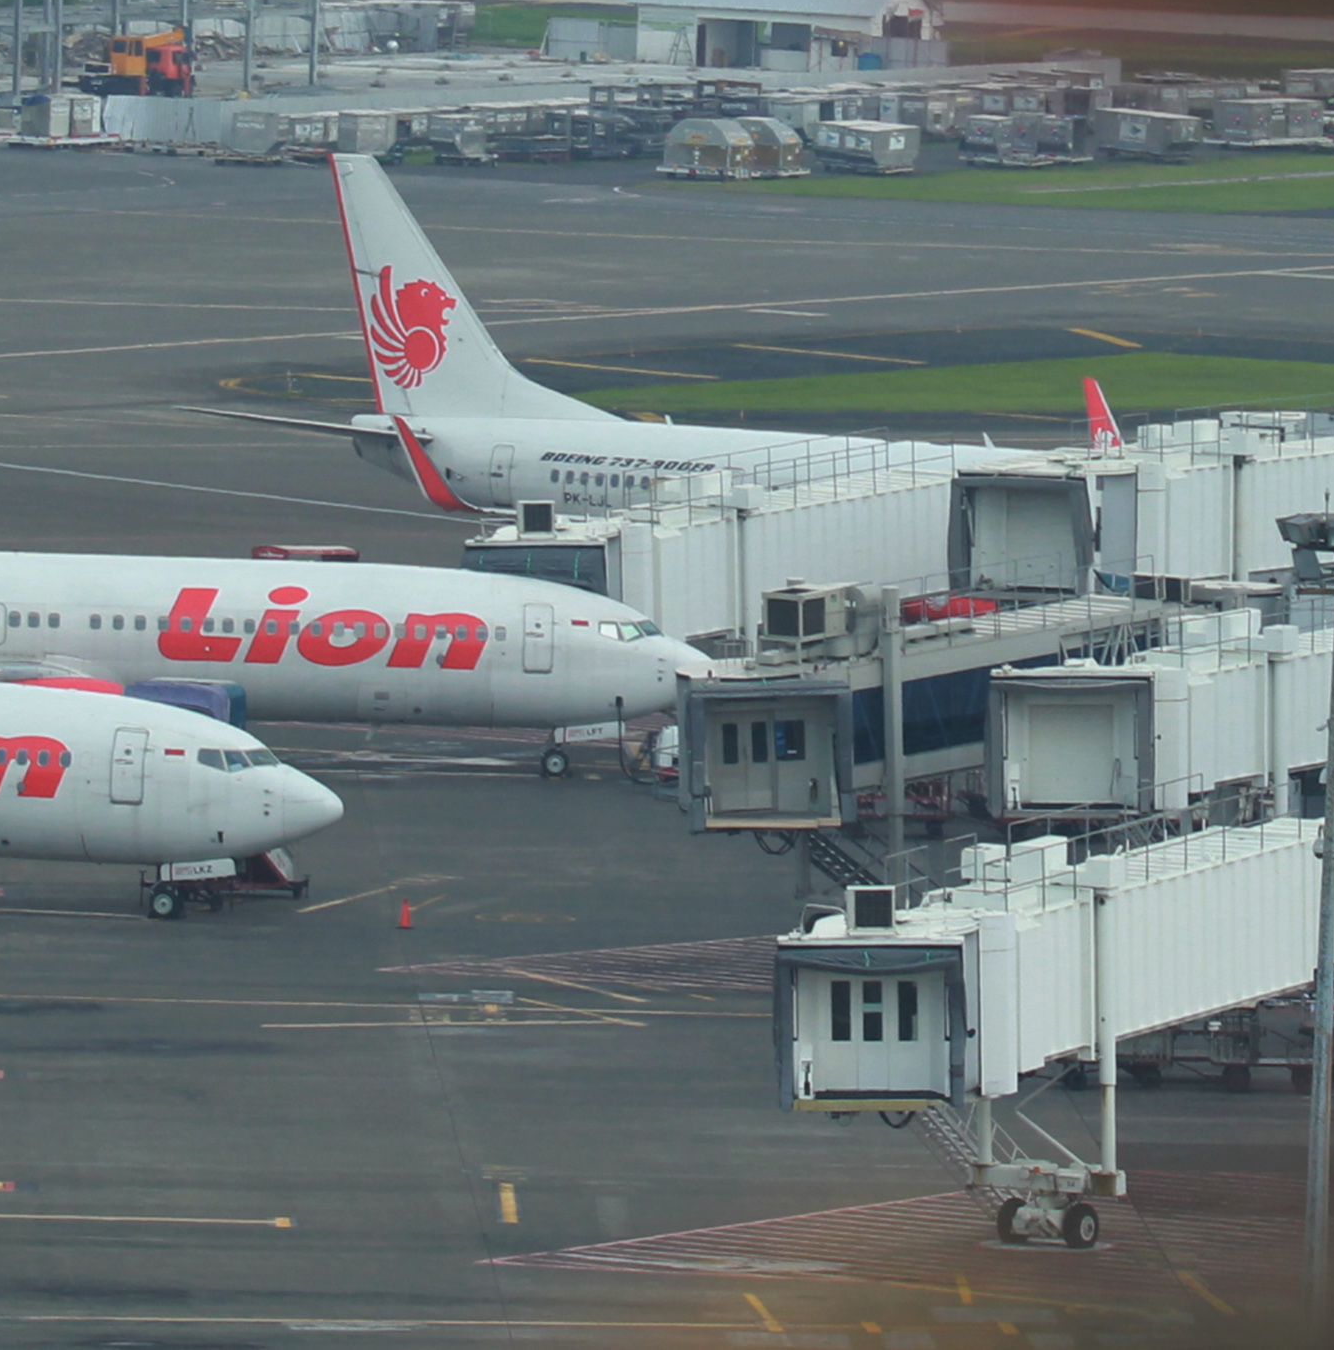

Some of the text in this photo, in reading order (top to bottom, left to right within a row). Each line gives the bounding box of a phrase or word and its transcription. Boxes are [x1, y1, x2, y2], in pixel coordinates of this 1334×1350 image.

[540, 451, 608, 466] BOEING
[157, 586, 489, 670] Lion
[193, 865, 213, 875] LKZ
